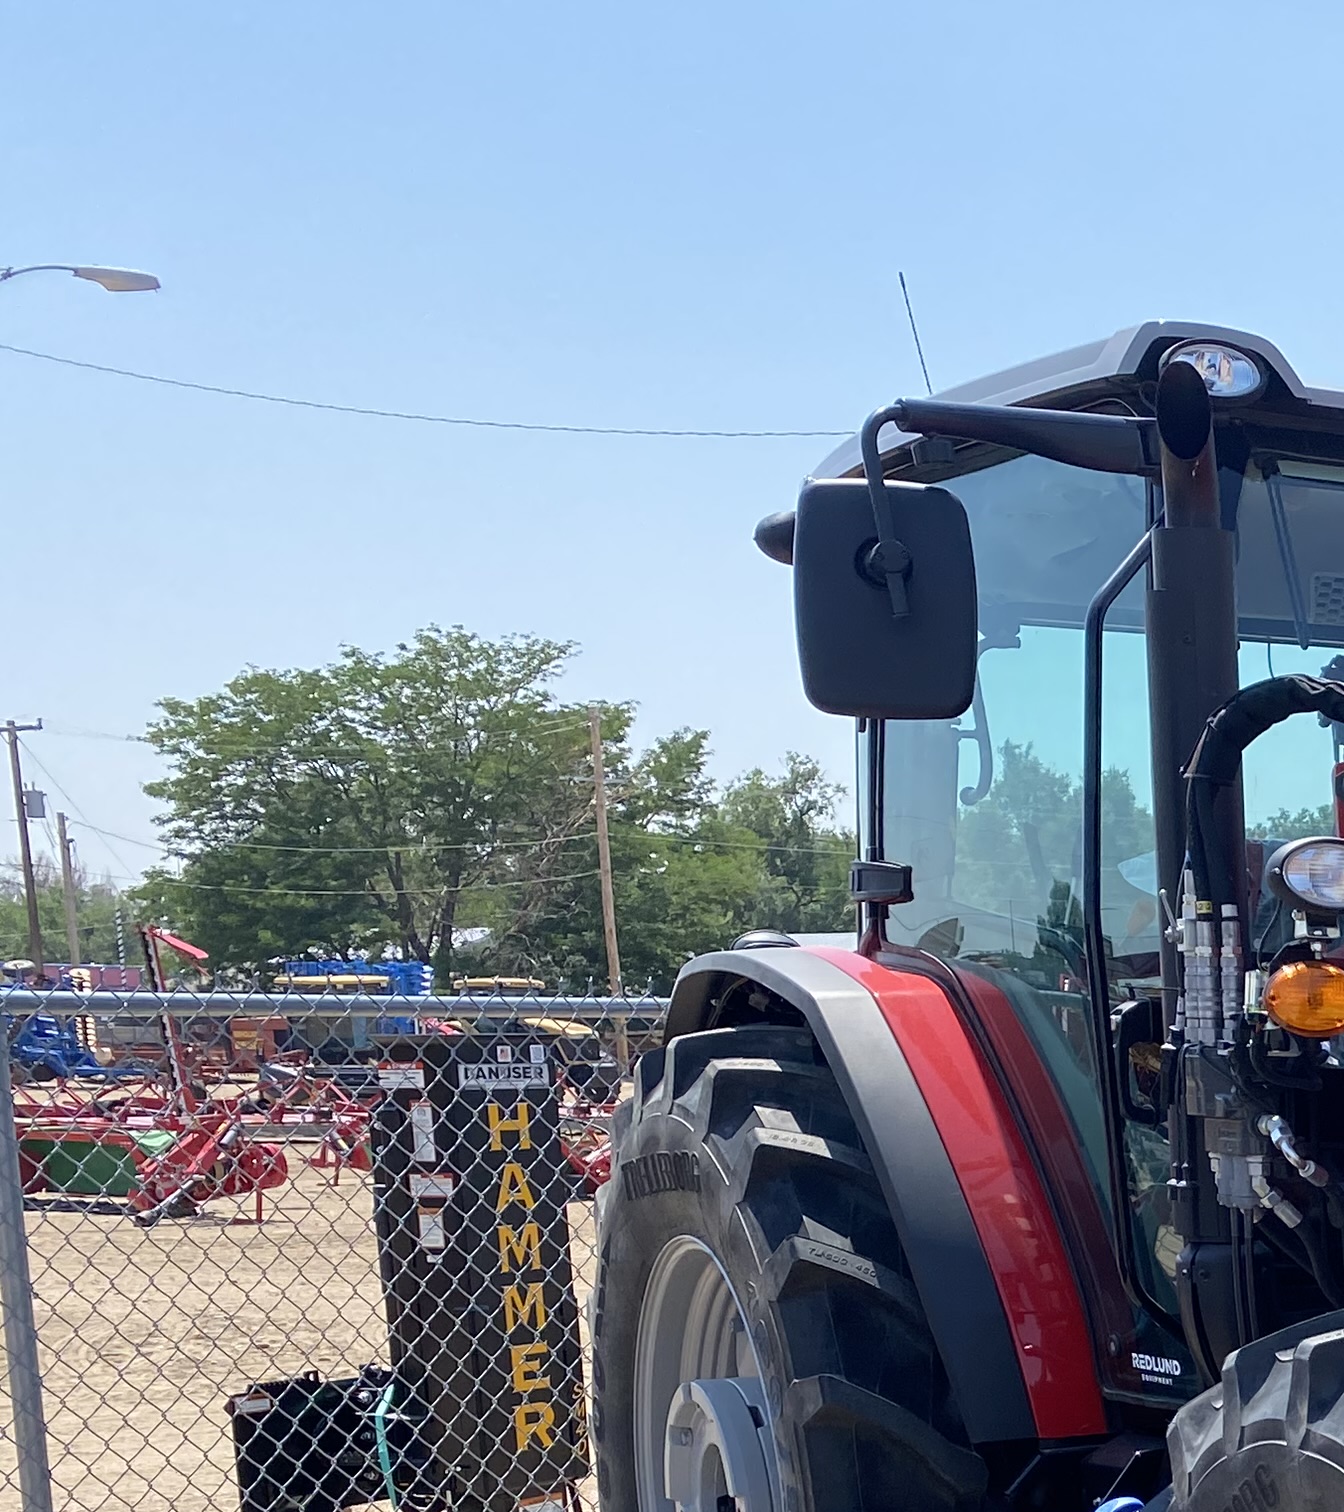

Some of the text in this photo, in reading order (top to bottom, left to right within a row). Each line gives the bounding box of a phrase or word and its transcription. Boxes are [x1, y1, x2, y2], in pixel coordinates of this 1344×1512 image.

[463, 1066, 544, 1081] DANUSER
[486, 1101, 556, 1451] HAMMER
[1131, 1352, 1181, 1376] REDLUND
